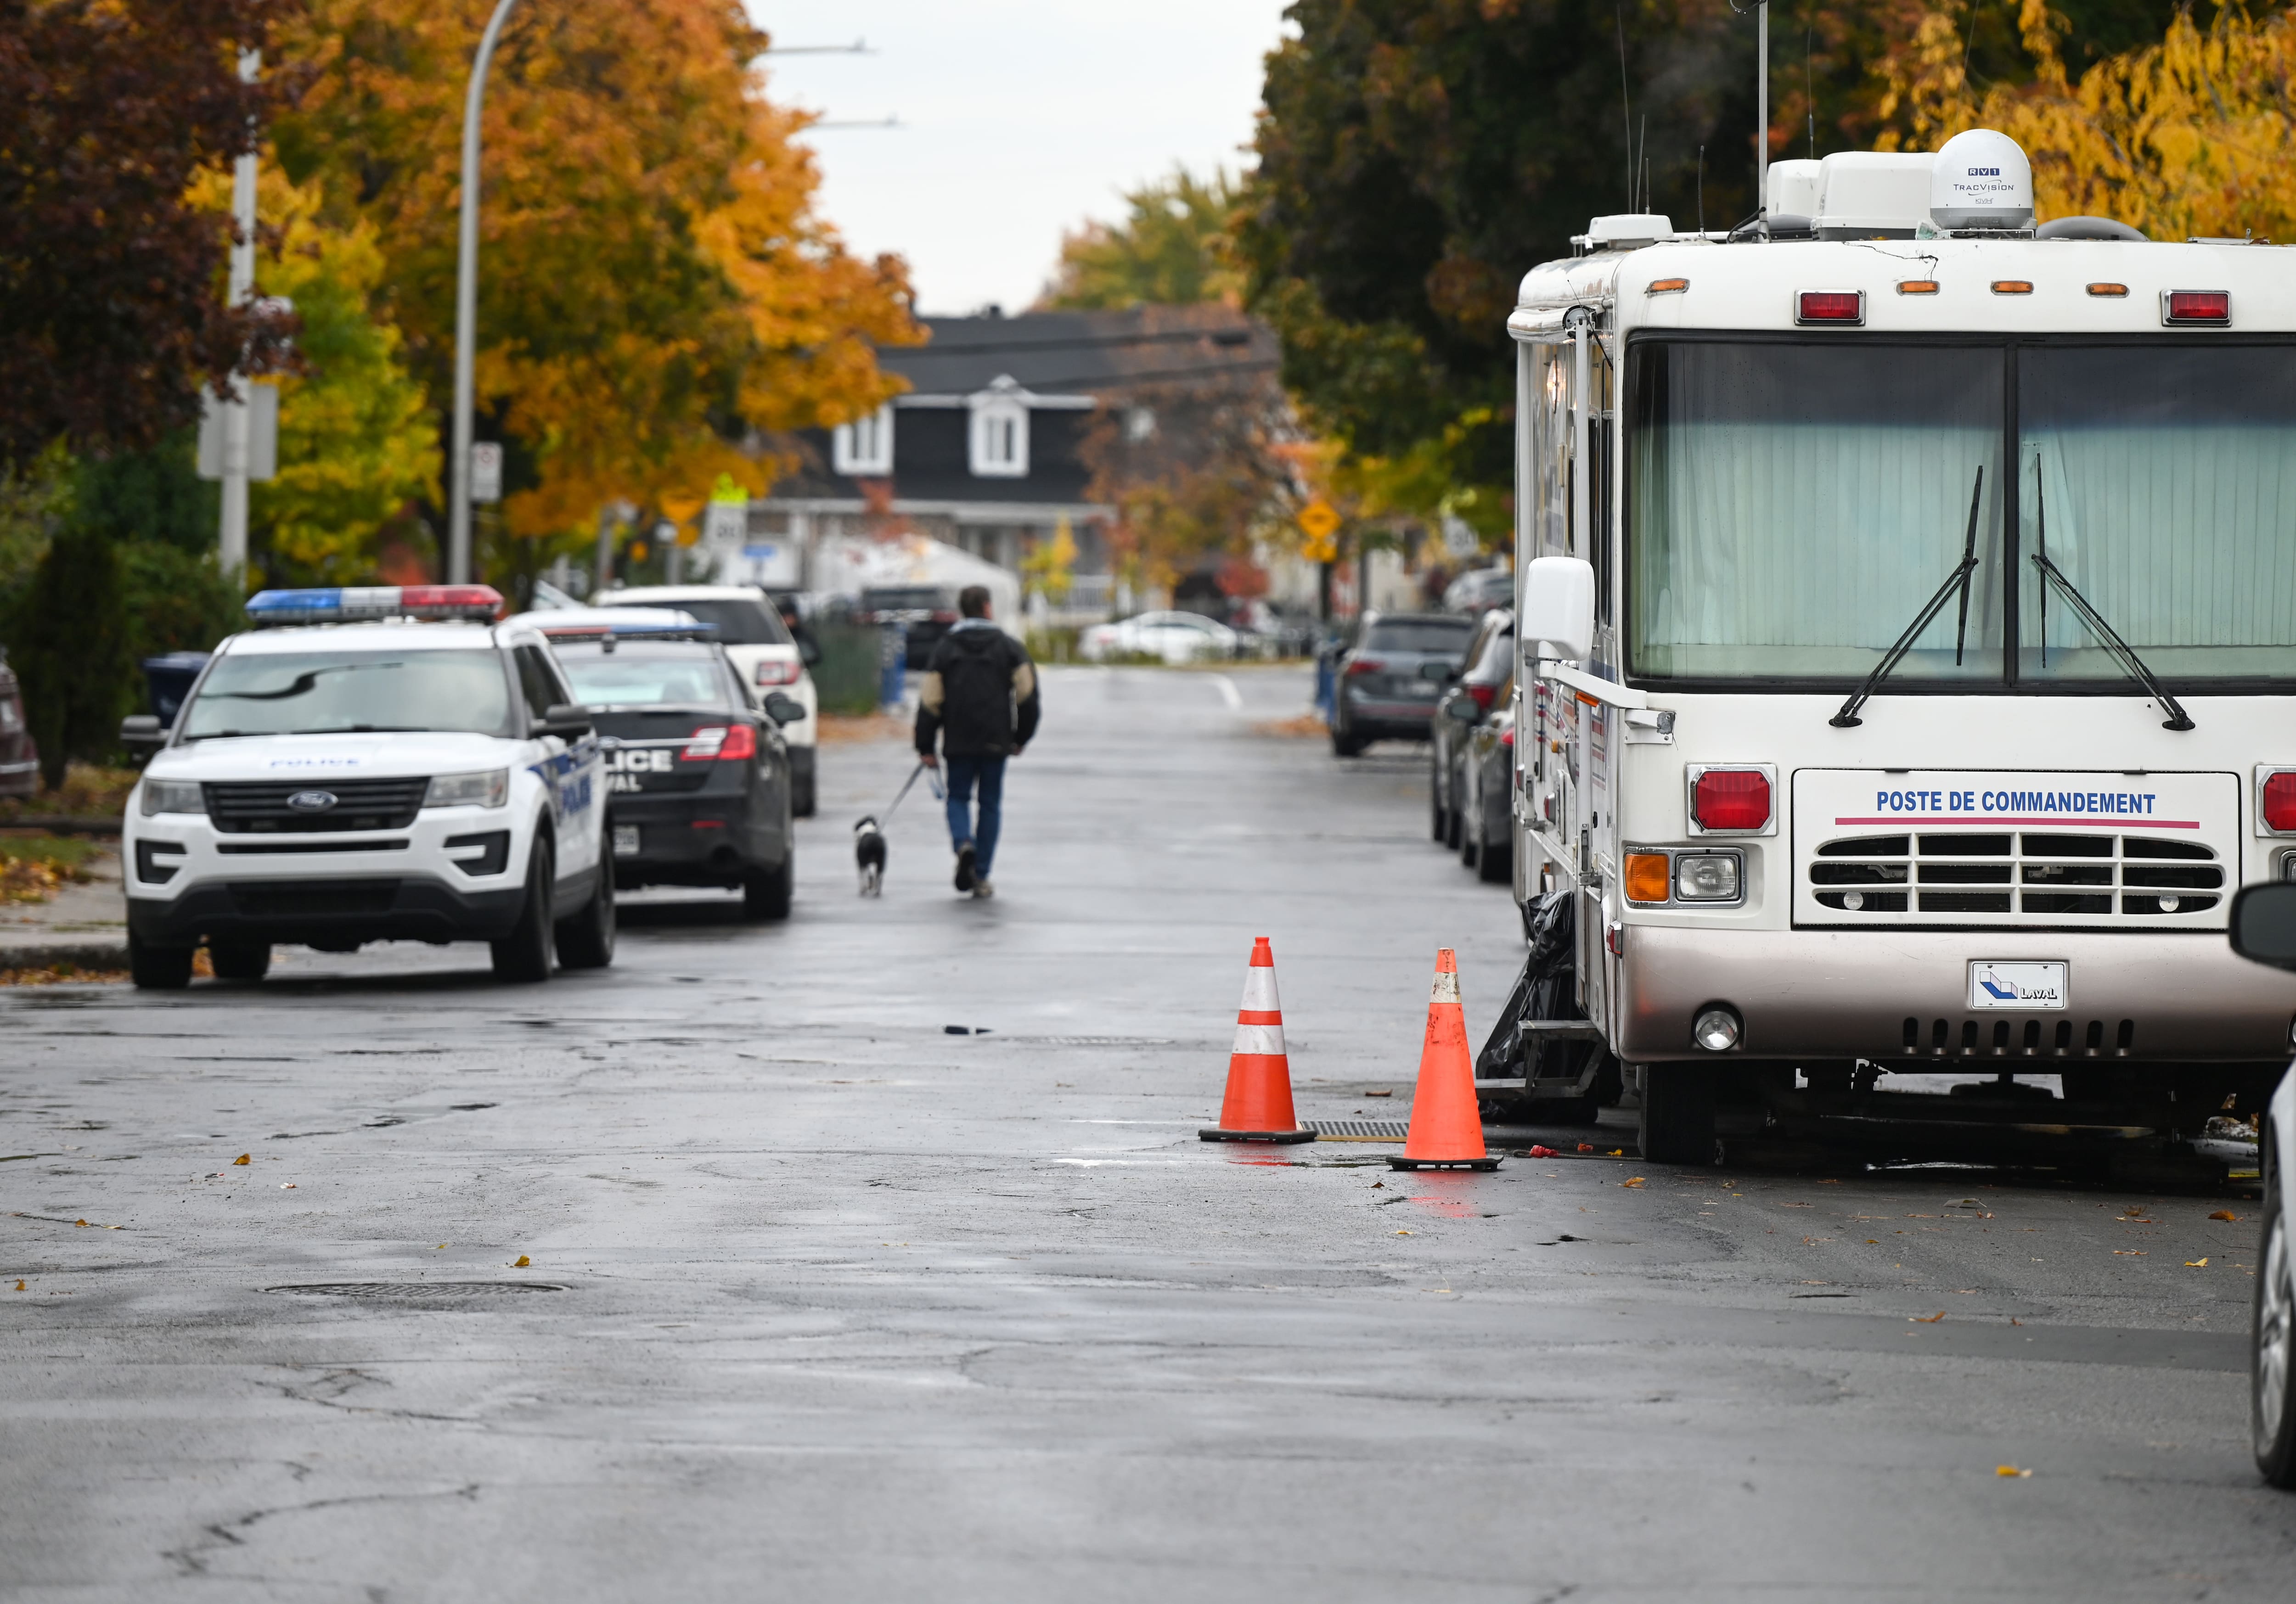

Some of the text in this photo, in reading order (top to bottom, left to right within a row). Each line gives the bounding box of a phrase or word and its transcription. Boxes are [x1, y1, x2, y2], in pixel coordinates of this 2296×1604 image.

[270, 759, 360, 769] POLICE
[1877, 791, 2155, 813] POSTE DE COMMANDEMENT
[2020, 988, 2058, 999] LAVAL
